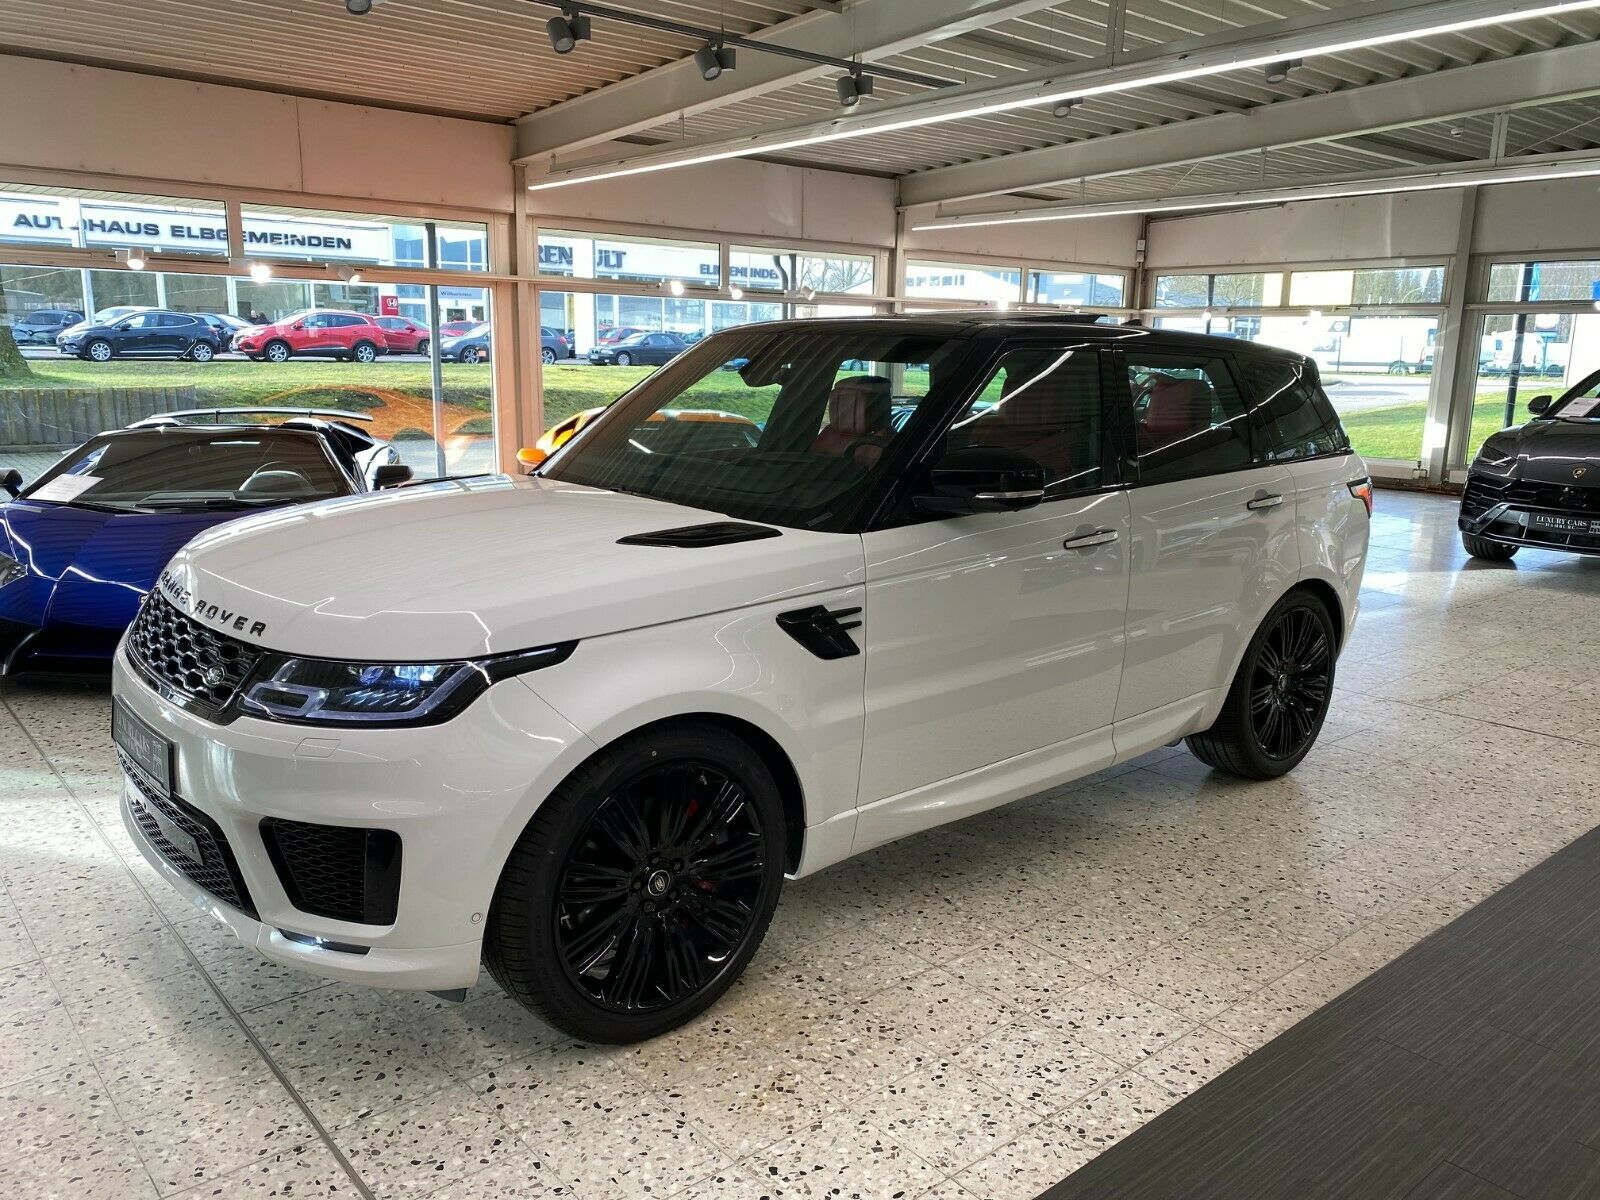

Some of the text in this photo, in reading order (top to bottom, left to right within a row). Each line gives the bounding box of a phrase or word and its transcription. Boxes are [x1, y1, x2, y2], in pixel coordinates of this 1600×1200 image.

[1567, 519, 1588, 527] CARS
[160, 571, 266, 637] RANGE ROVER
